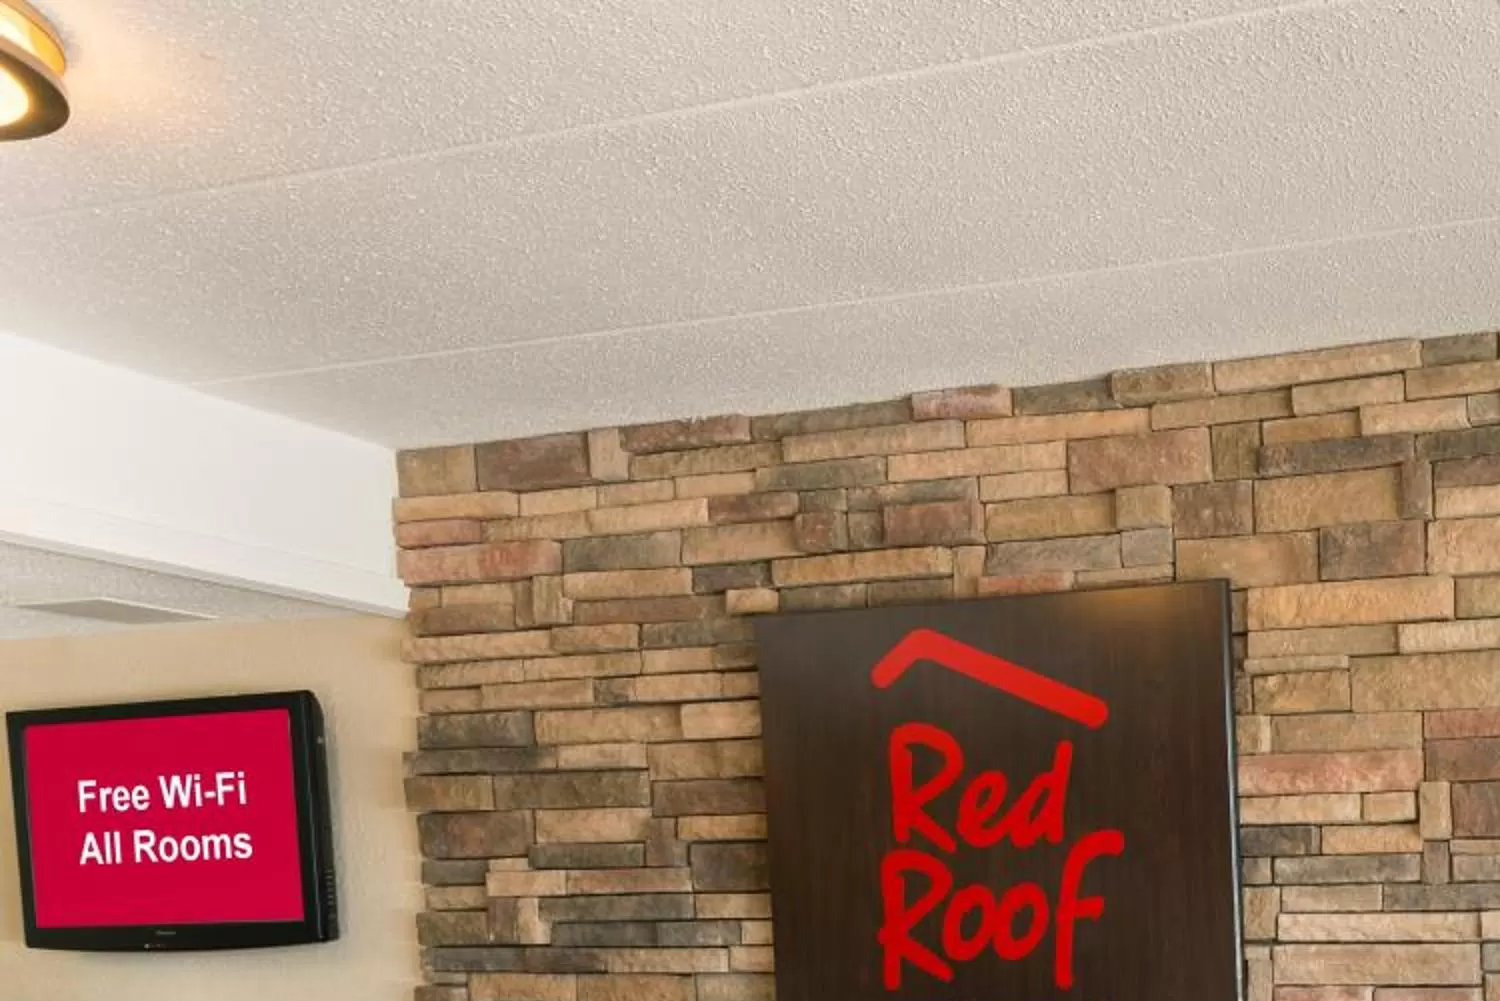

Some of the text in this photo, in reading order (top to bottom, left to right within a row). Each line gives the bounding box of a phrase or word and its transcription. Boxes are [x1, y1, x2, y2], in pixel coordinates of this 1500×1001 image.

[77, 771, 248, 814] Free Wi-Fi
[887, 721, 1073, 854] Red
[79, 828, 254, 866] All Rooms
[877, 829, 1126, 991] Roof
